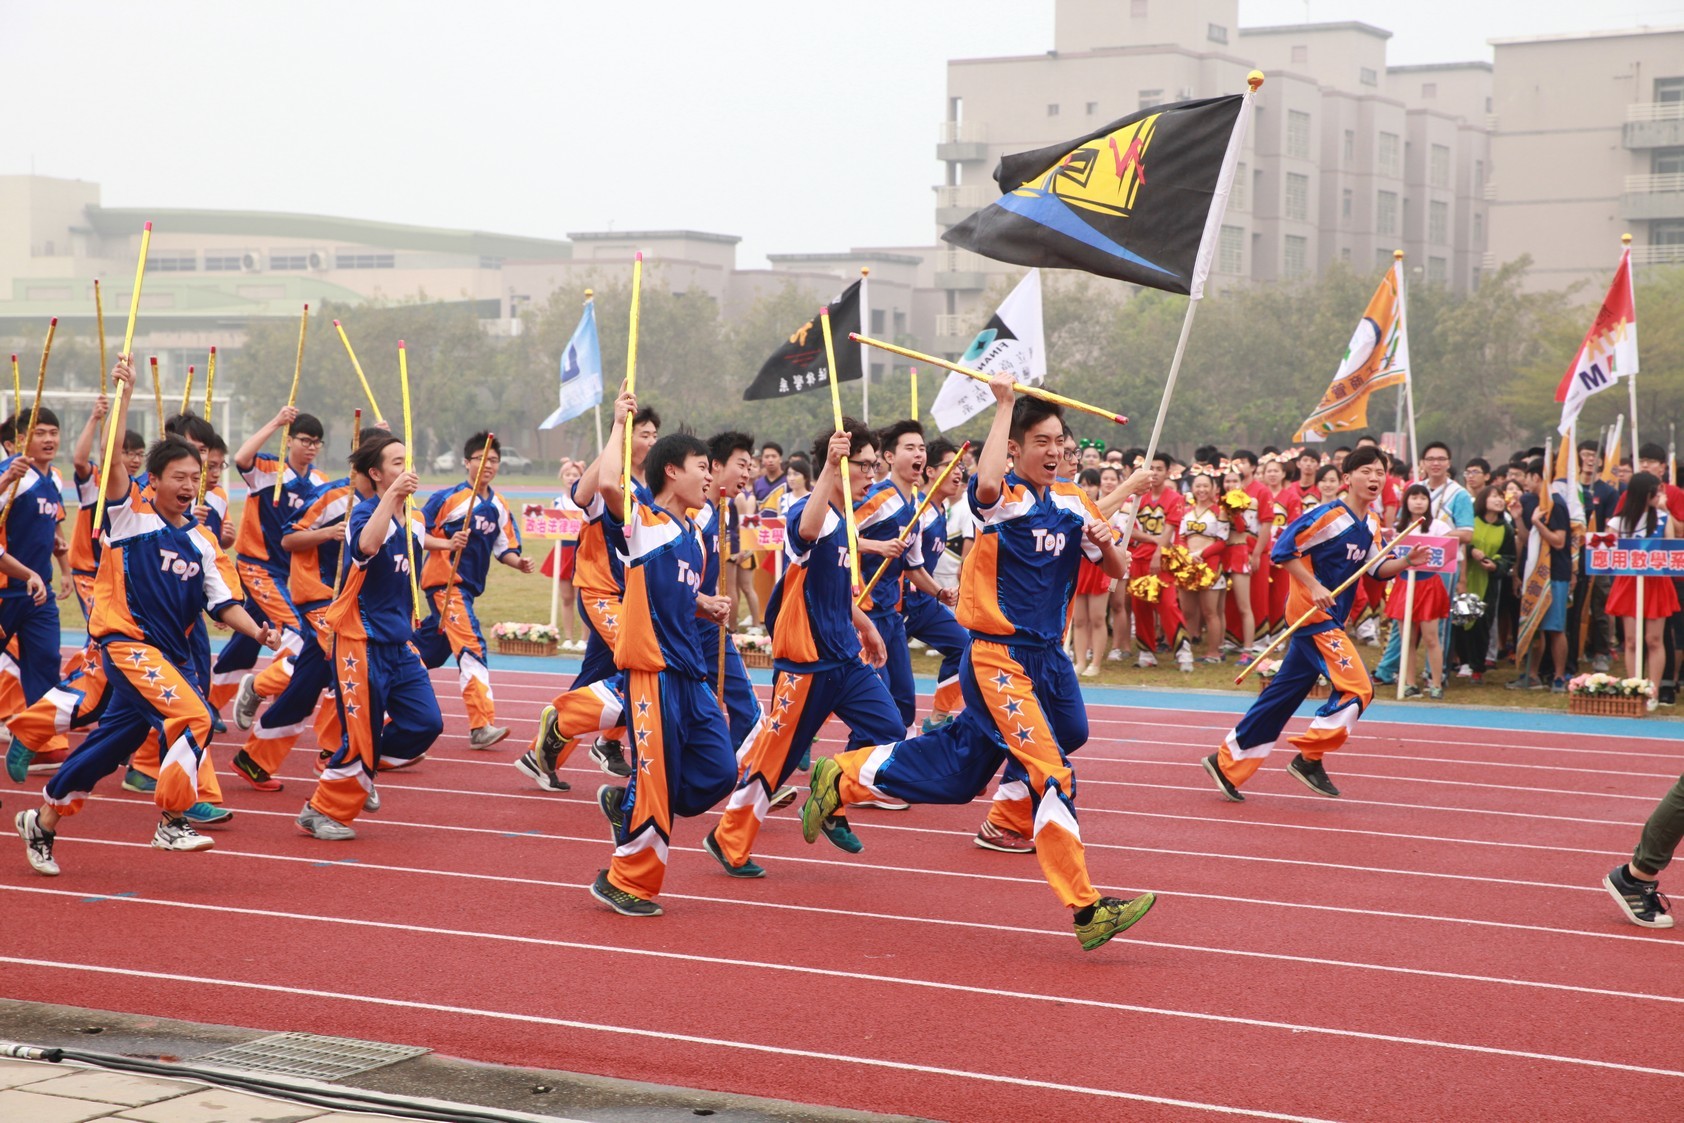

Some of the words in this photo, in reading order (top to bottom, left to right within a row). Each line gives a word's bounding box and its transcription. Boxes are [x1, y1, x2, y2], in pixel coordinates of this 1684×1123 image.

[37, 497, 57, 518] Top
[288, 491, 305, 510] To
[474, 514, 496, 535] Top
[1186, 520, 1208, 533] Top
[1031, 528, 1066, 557] Top
[1345, 543, 1366, 562] Top
[160, 549, 200, 581] Top
[393, 554, 410, 576] To
[837, 546, 851, 569] To
[1591, 549, 1684, 570] 應用數學系
[677, 558, 701, 594] Top
